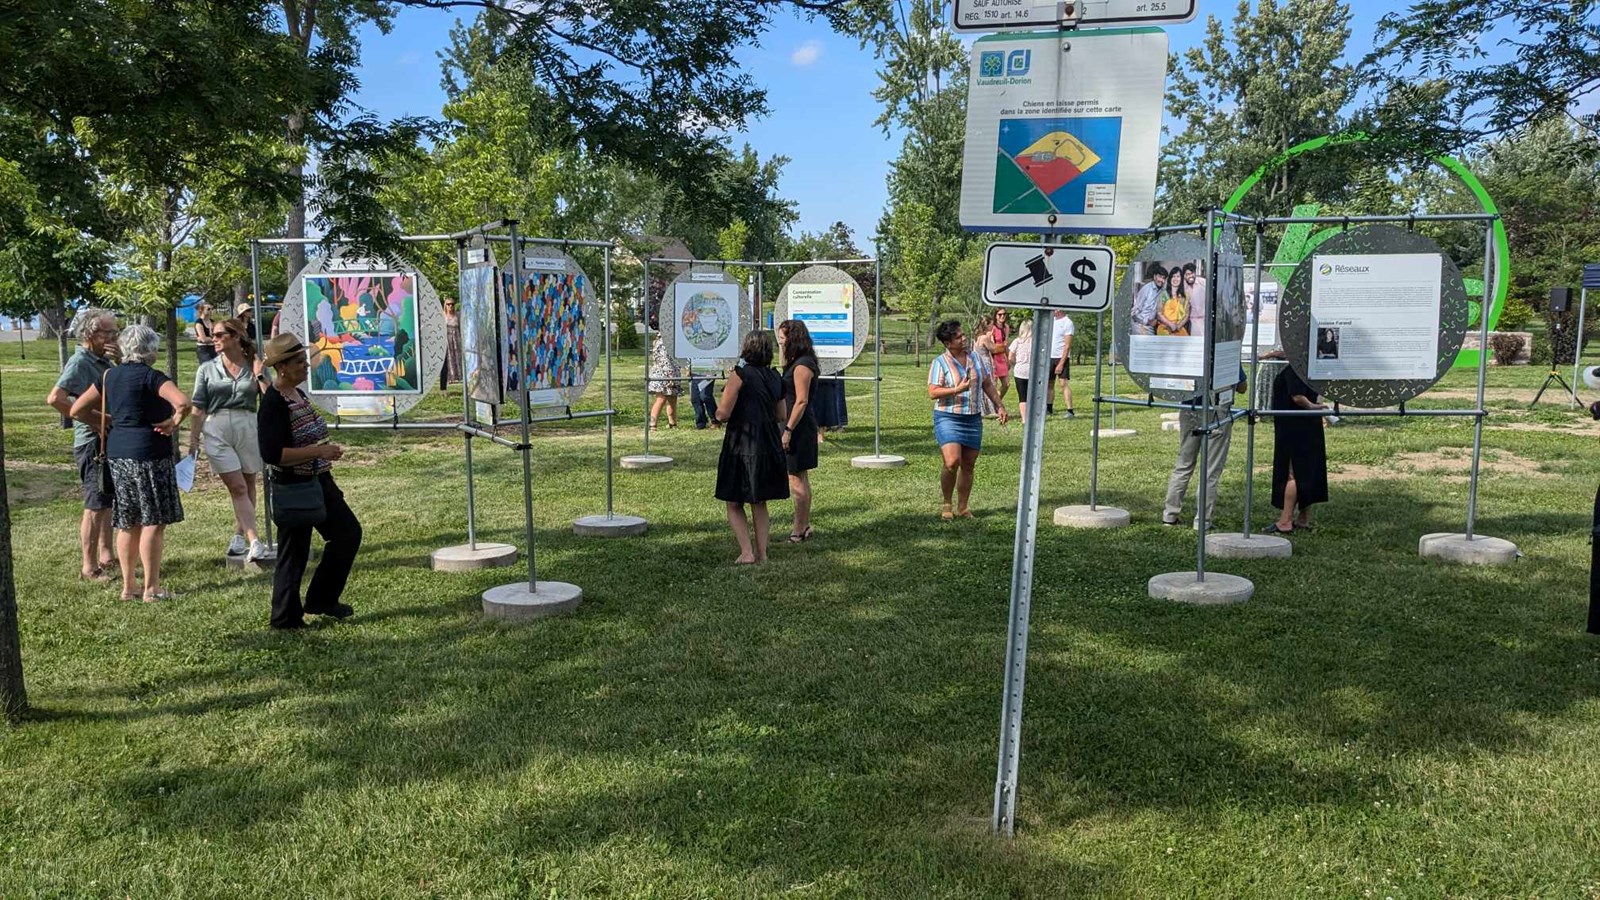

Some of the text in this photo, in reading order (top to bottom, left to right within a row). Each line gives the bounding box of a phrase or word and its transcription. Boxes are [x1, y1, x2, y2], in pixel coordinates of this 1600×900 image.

[1136, 4, 1148, 12] art.
[1151, 2, 1167, 11] 25.5
[984, 10, 999, 18] 1510
[1001, 11, 1013, 19] art.
[1015, 9, 1029, 18] 14.6
[976, 78, 1031, 86] Vaudreuil-Dorion
[1077, 99, 1099, 108] permis
[1041, 106, 1072, 114] identifiée
[1334, 264, 1370, 273] Réseaux
[1068, 256, 1097, 300] $
